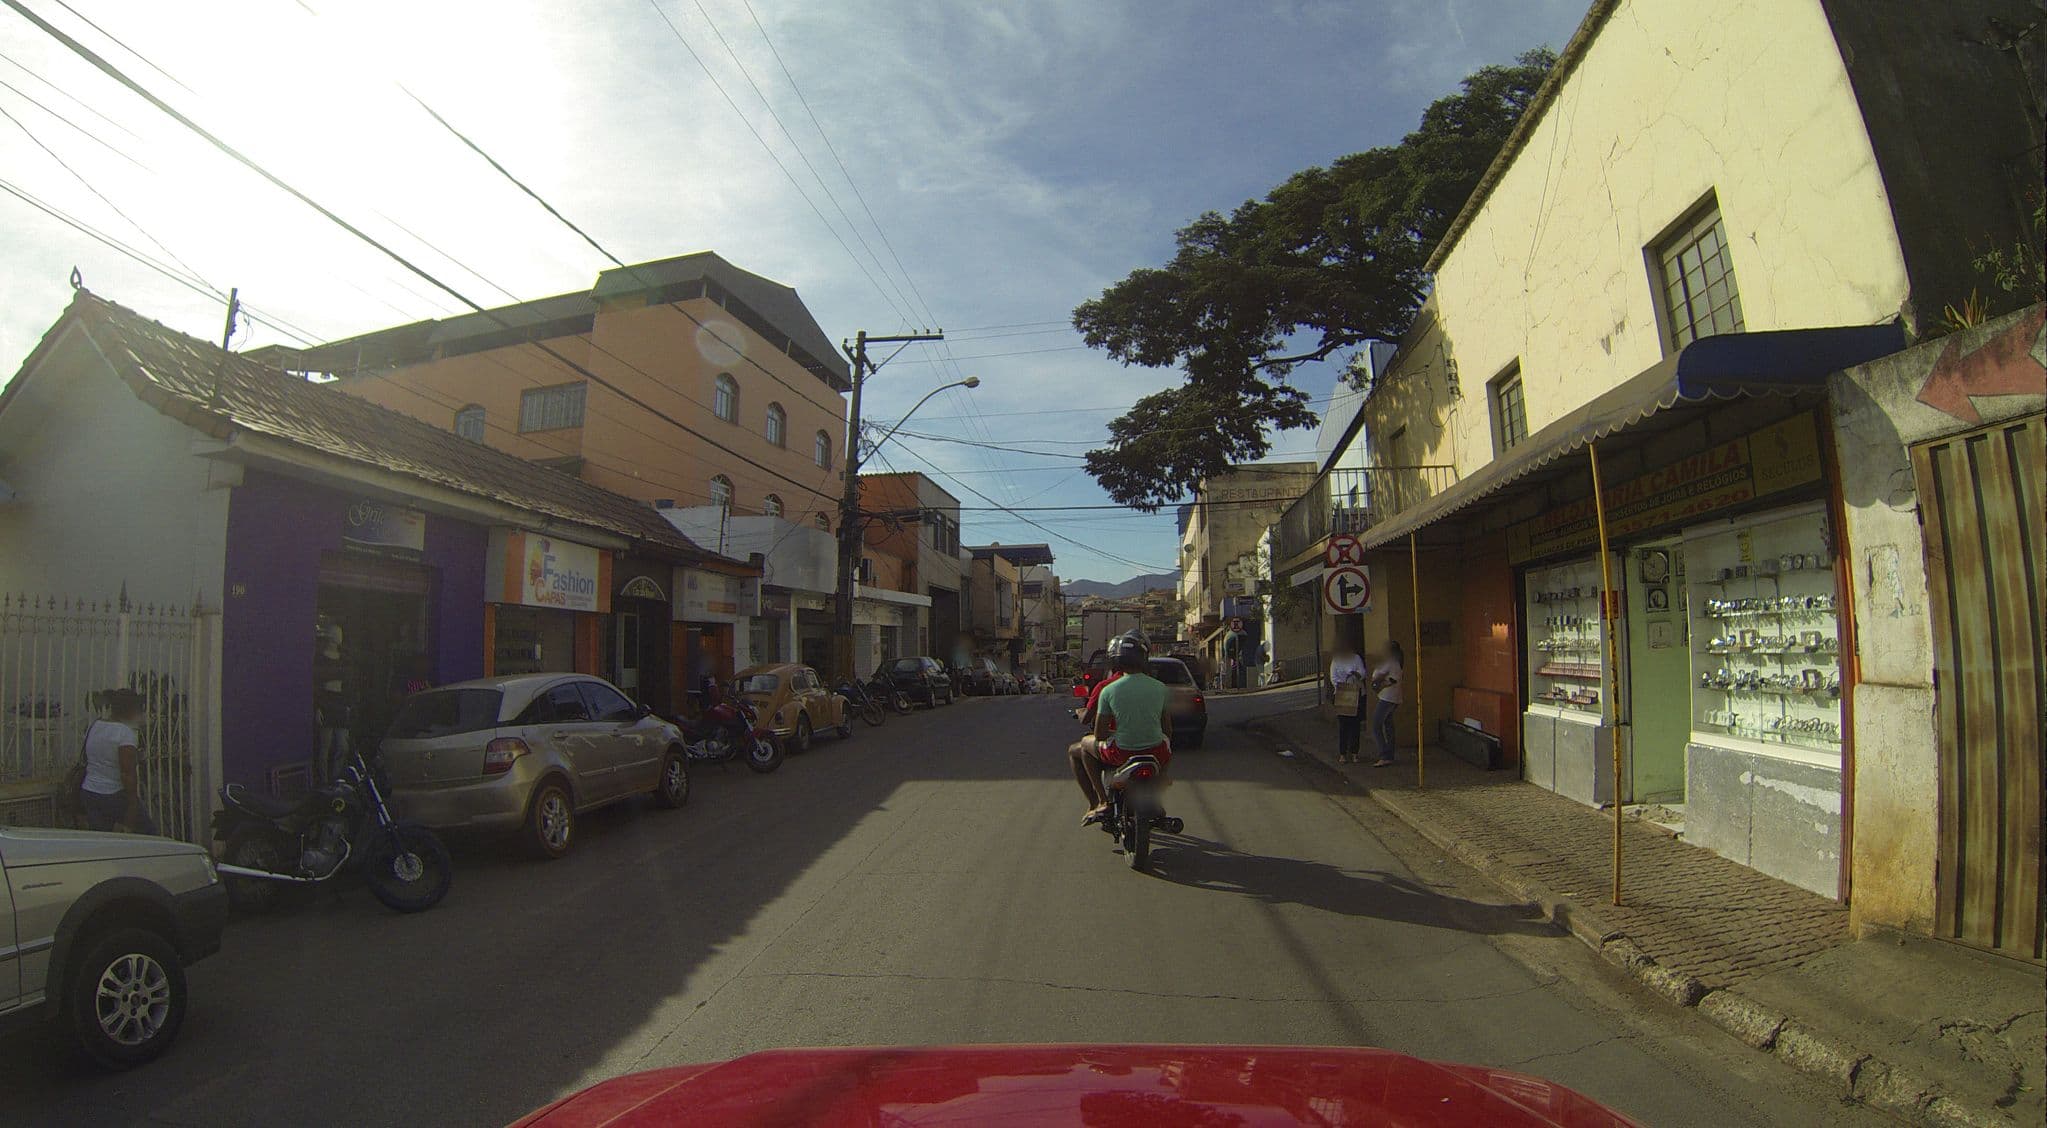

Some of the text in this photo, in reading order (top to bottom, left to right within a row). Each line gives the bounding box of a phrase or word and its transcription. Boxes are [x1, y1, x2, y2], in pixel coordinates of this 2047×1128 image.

[1651, 443, 1739, 490] CAMILA
[1221, 486, 1305, 499] RESTAURANTE
[535, 577, 566, 605] CAPAS
[543, 554, 594, 594] Fashion
